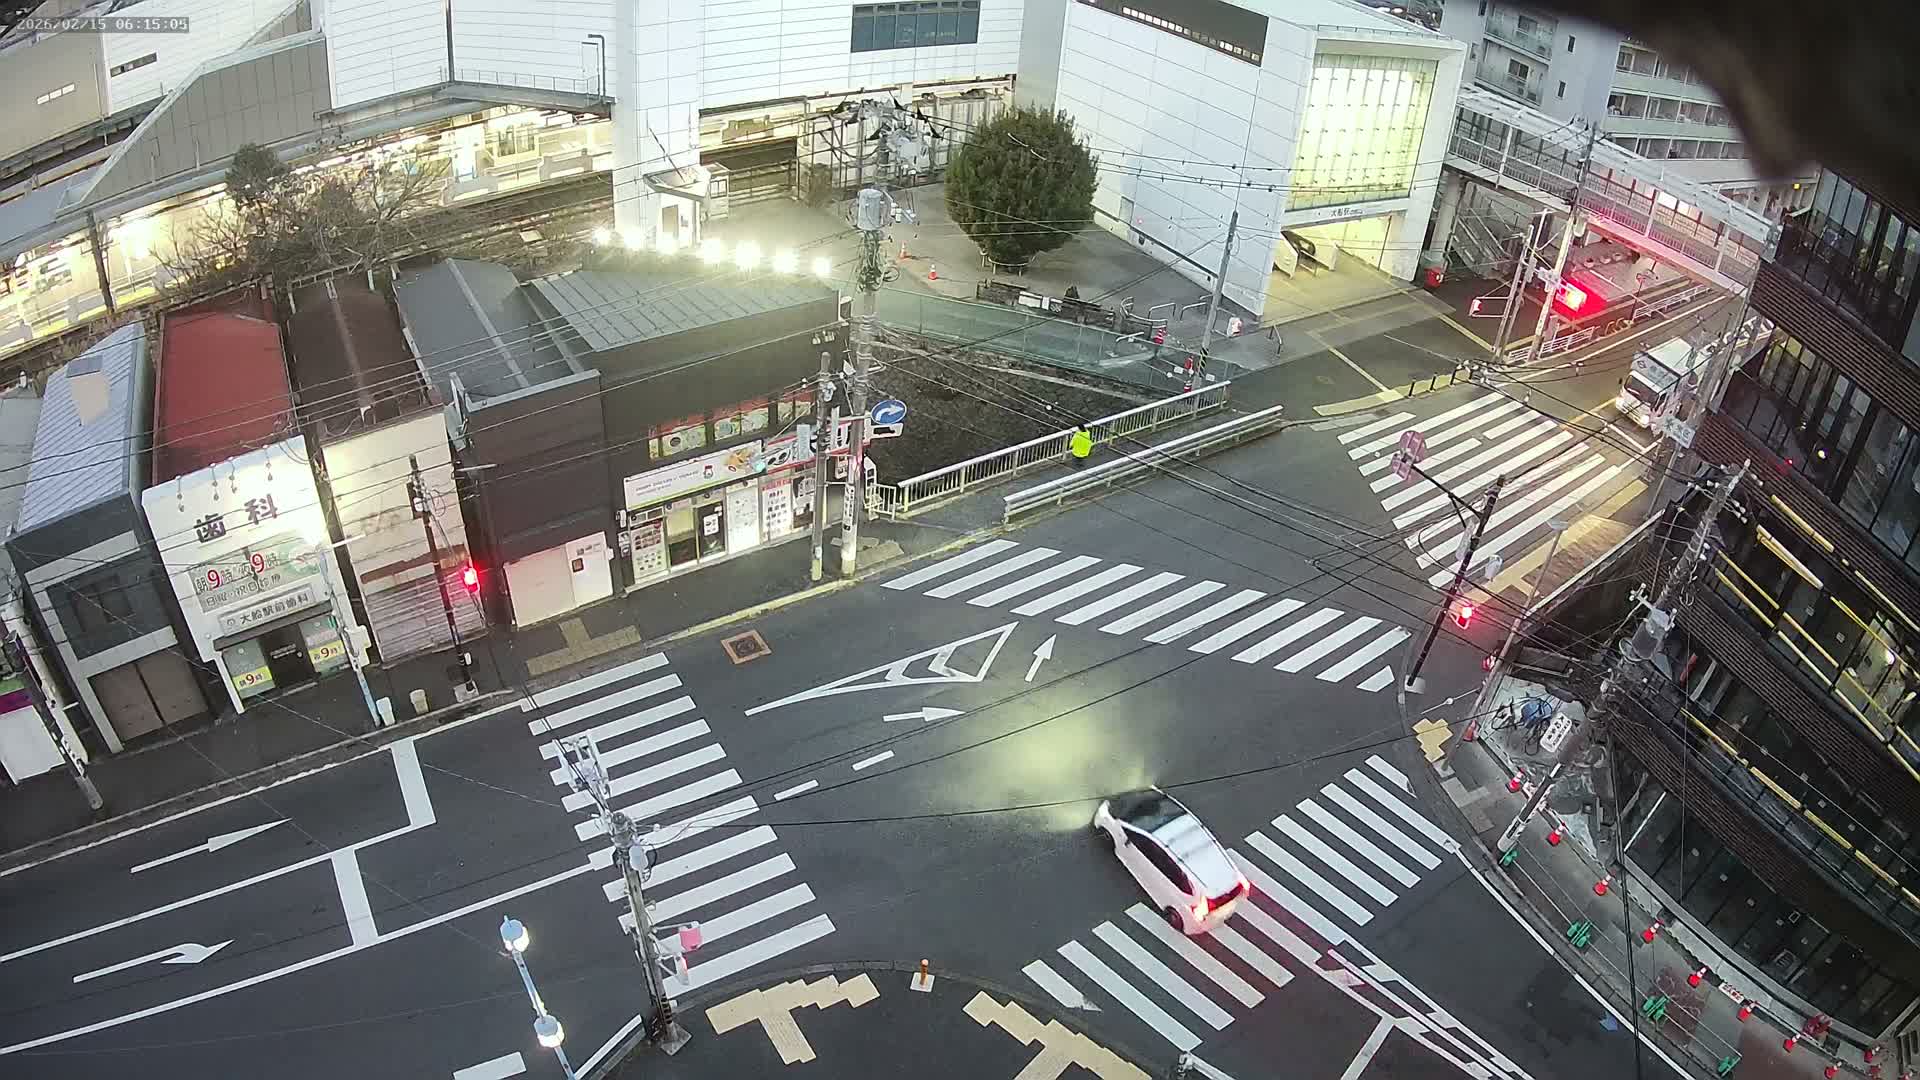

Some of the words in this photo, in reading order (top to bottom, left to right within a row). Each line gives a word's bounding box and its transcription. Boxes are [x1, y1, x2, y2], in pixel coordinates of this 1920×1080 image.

[194, 493, 278, 543] 歯科
[195, 569, 233, 594] 朝9時
[239, 593, 309, 625] 大船駅前歯科
